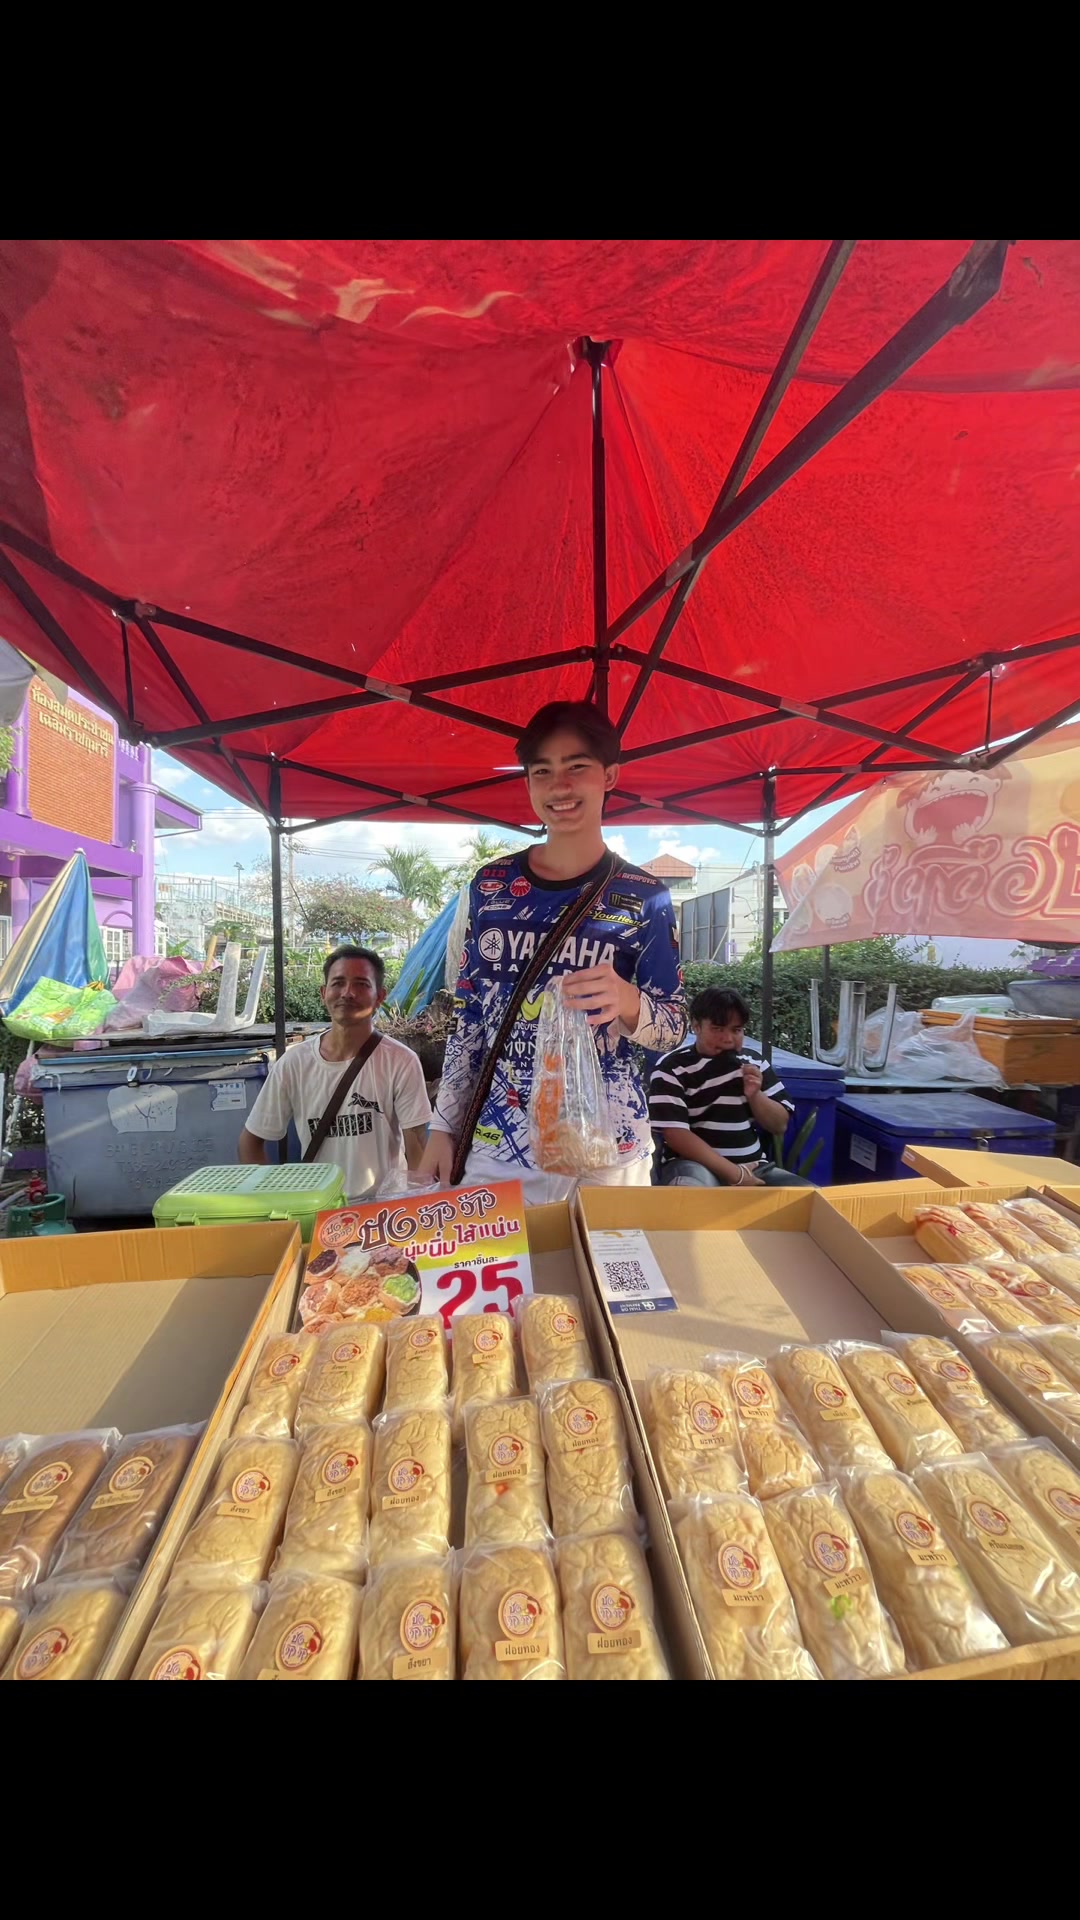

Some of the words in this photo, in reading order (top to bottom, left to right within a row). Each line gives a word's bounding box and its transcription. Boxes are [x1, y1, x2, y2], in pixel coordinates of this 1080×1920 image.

[507, 930, 616, 968] YAAHA
[307, 1112, 372, 1137] PMA
[454, 1255, 499, 1269] ราคาชิ้นละ
[436, 1261, 523, 1330] 25
[505, 1644, 540, 1656] ฝอยทอง
[597, 1637, 633, 1649] ฝอยทอง
[407, 1657, 432, 1670] สังขยา
